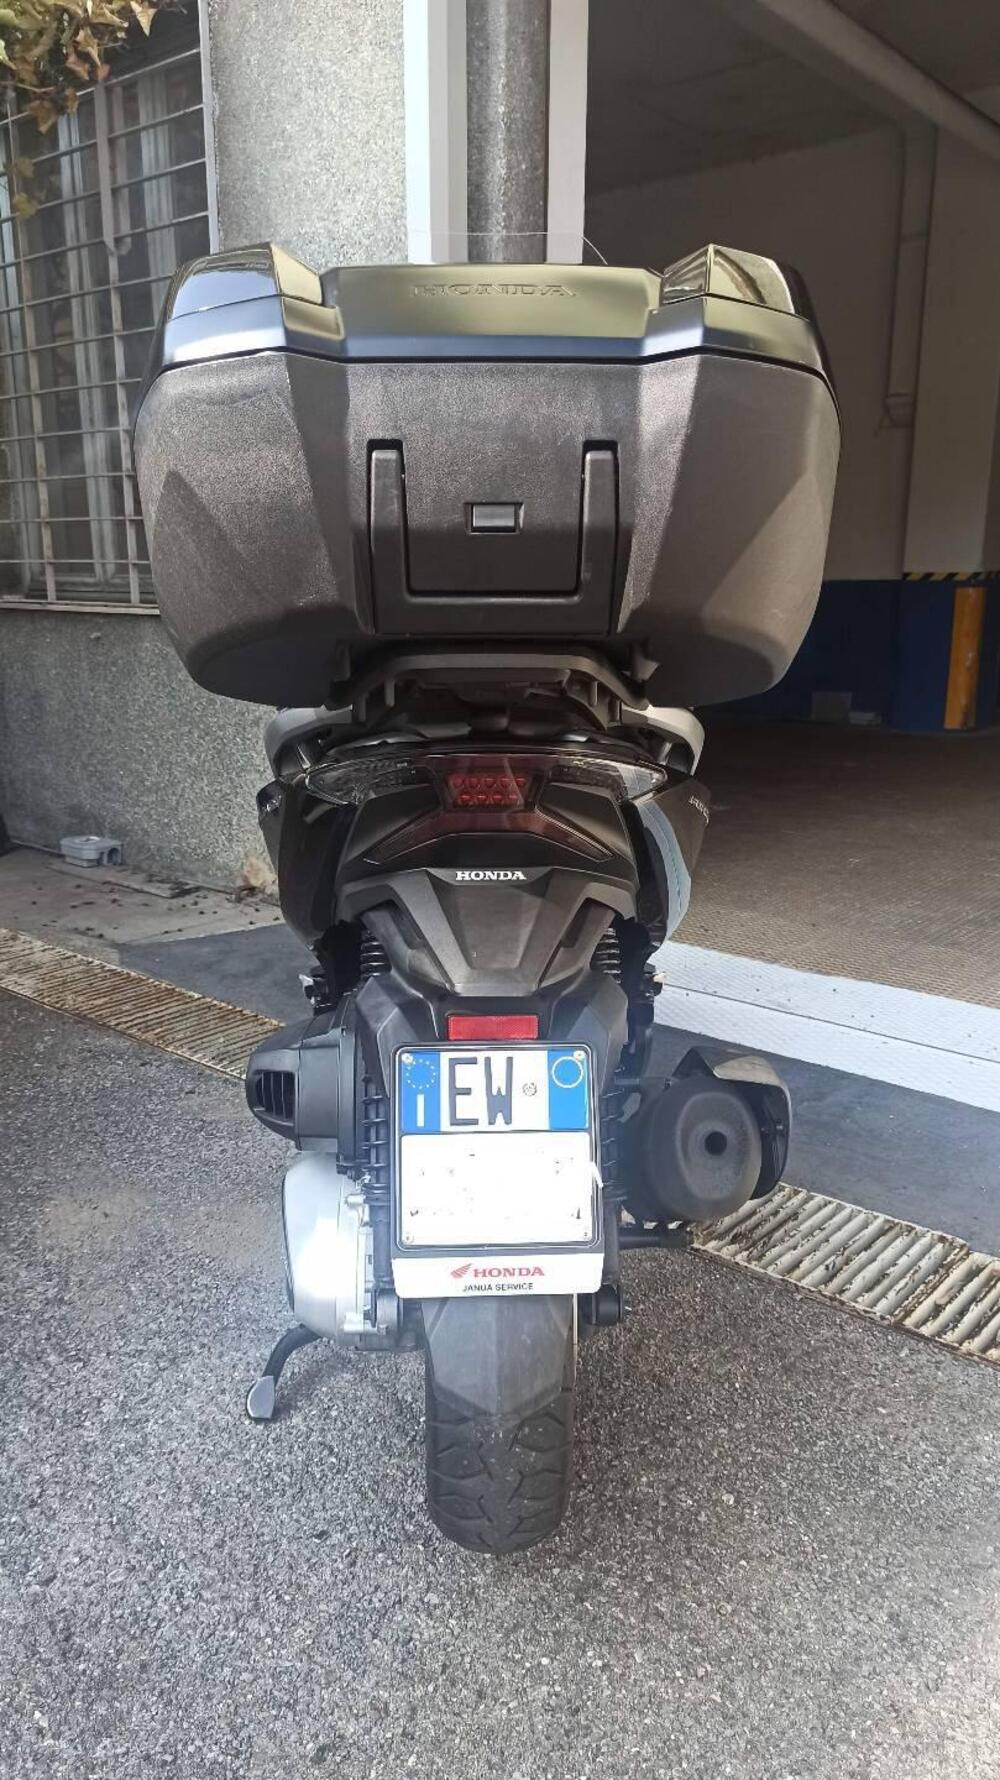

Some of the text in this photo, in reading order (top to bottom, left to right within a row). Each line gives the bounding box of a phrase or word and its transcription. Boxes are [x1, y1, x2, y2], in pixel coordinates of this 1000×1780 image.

[455, 871, 528, 881] HONDA
[448, 1056, 514, 1127] EW
[473, 1266, 545, 1278] HONDA
[463, 1282, 534, 1292] JANUA SERVICE
